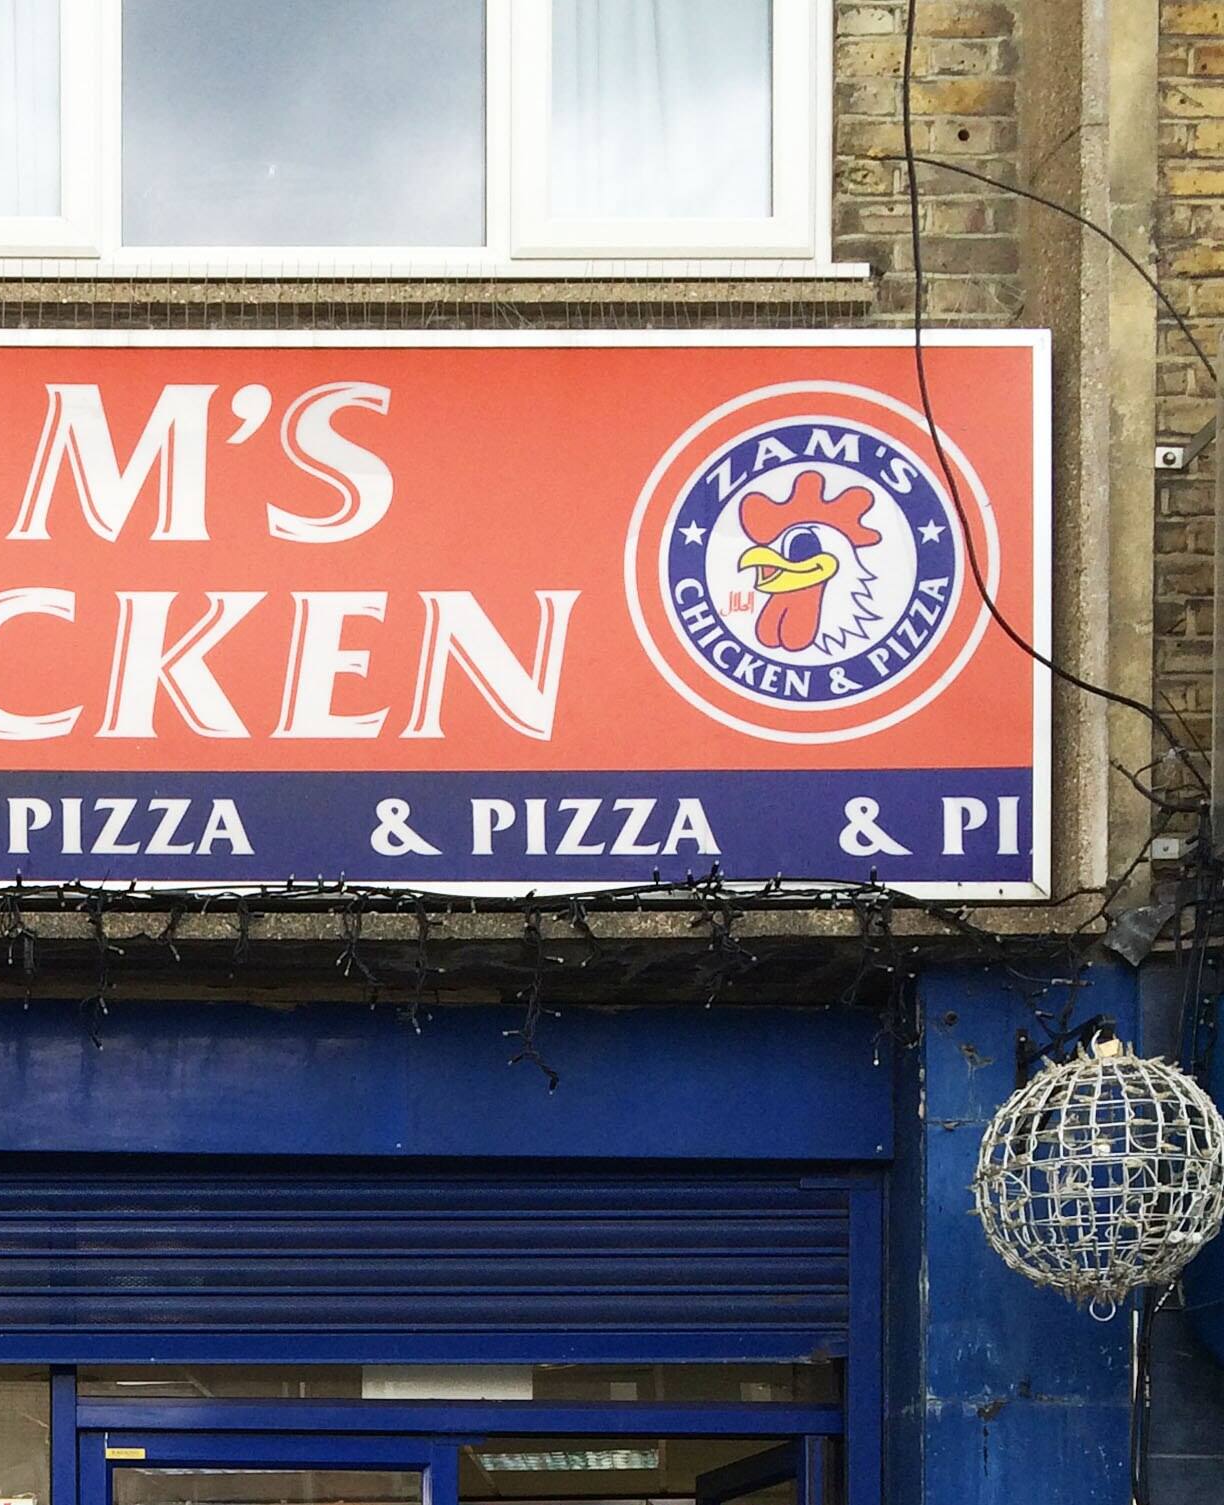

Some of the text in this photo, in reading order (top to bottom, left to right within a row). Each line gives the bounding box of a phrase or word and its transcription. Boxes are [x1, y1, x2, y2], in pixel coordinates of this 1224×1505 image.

[706, 428, 916, 502] ZAM'S
[675, 574, 950, 699] CHICKEN & PIZZA
[7, 797, 255, 855] PIZZA
[370, 798, 444, 856] &
[470, 797, 722, 857] PIZZA
[838, 797, 914, 857] &
[941, 796, 1033, 856] PI
